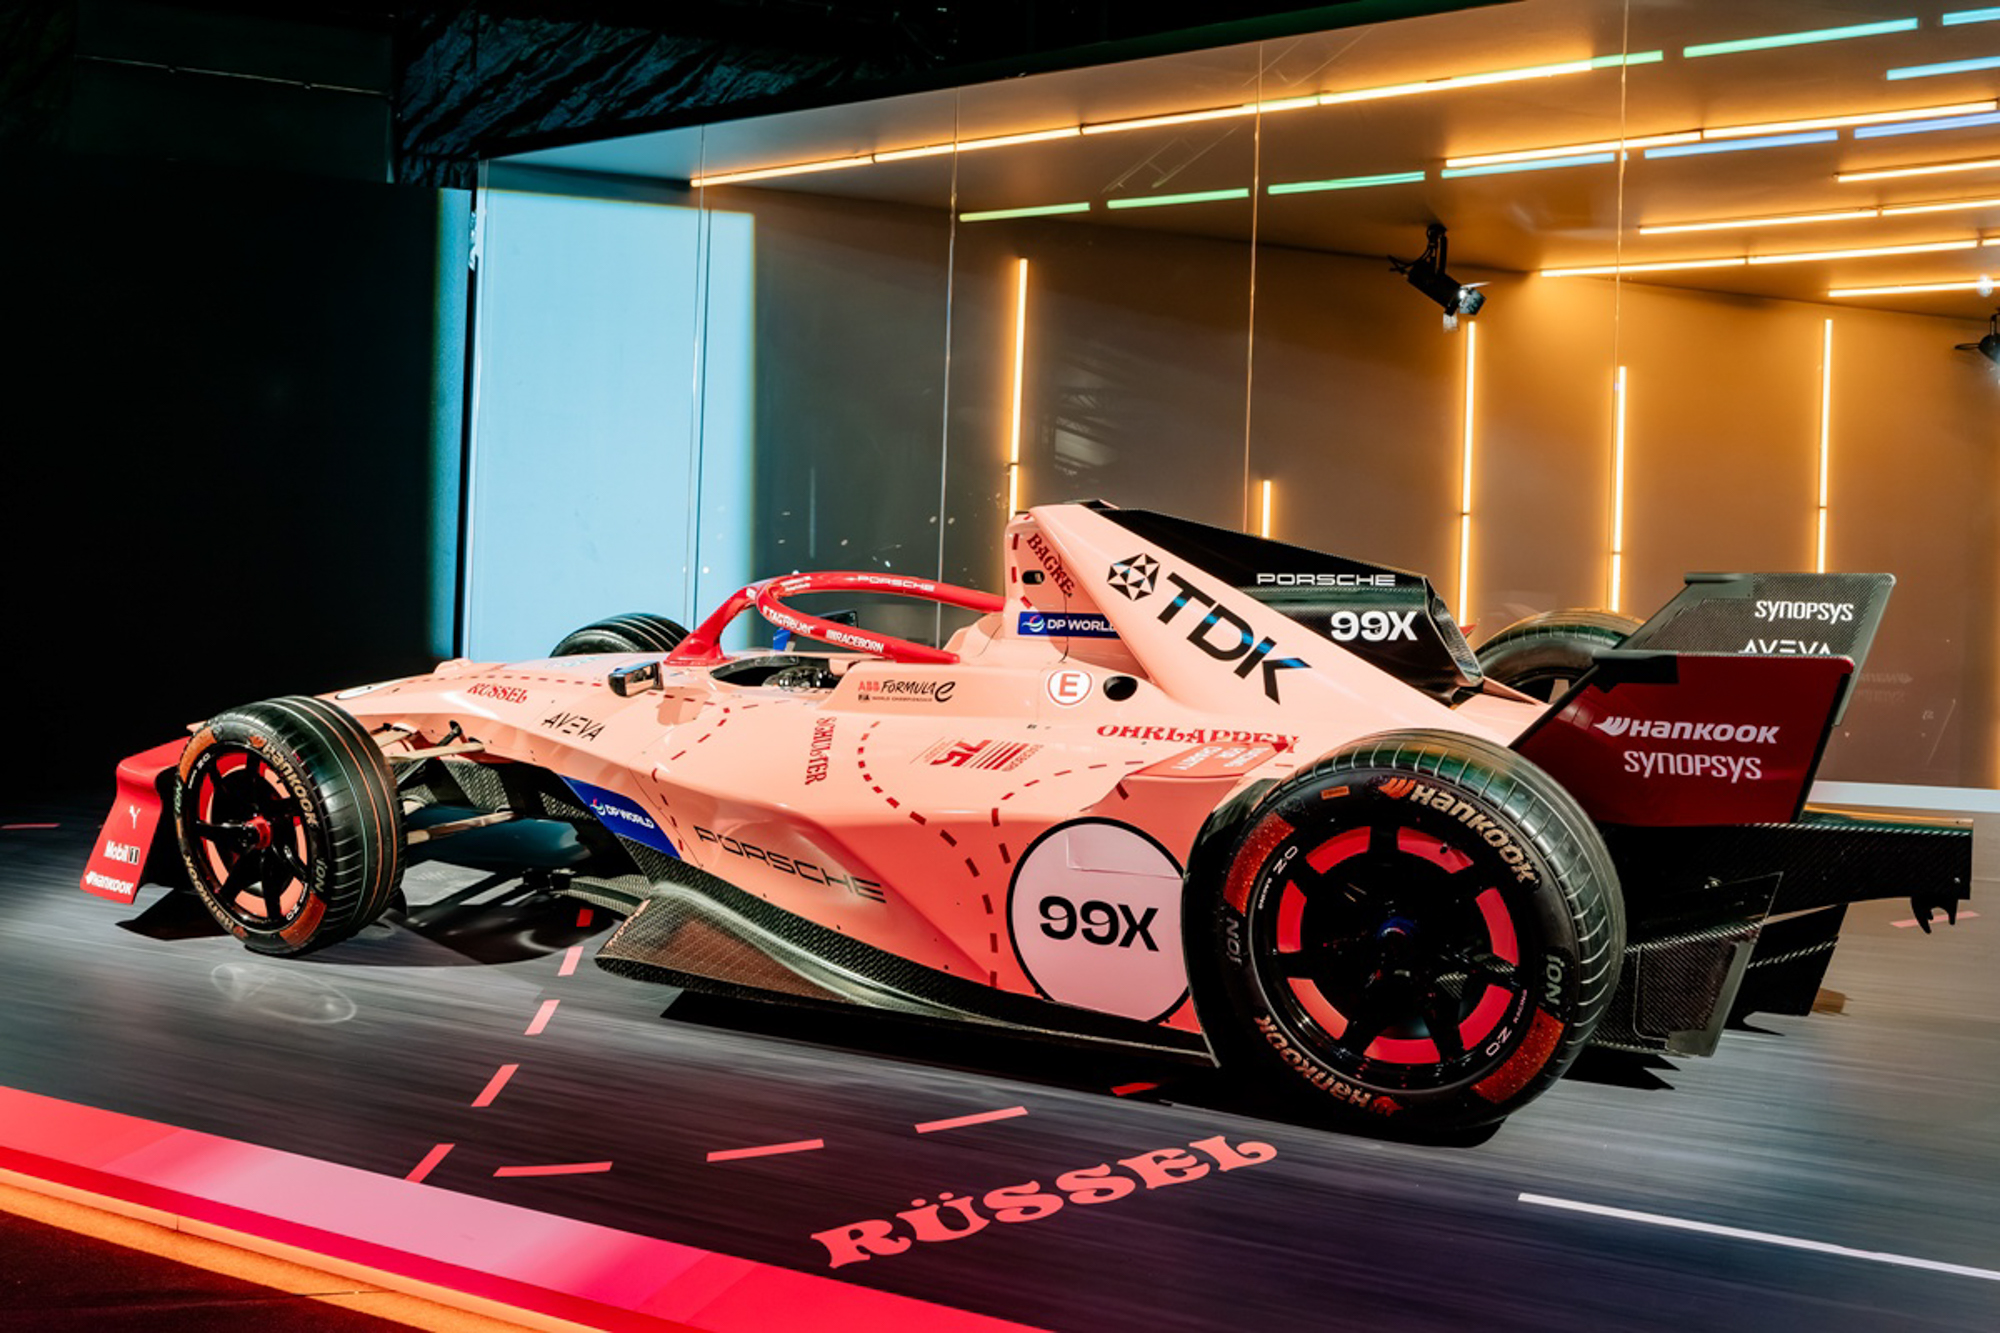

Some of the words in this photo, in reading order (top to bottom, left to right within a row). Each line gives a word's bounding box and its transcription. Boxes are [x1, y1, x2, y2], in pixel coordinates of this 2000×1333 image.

[857, 575, 935, 592] PORSCHE
[1256, 573, 1396, 587] PORSCHE
[1047, 619, 1067, 630] DP
[1754, 600, 1854, 625] SYNOPSYS
[1157, 572, 1312, 705] TDK
[1331, 610, 1418, 642] 99X
[836, 632, 884, 653] RACEBORN
[1738, 639, 1831, 655] AVEVA
[858, 681, 880, 691] ABB
[881, 680, 937, 695] FORMULA
[1059, 673, 1080, 697] E
[542, 712, 605, 741] AVEVA
[1623, 750, 1763, 784] SYNOPSYS
[604, 804, 619, 817] DP
[617, 808, 655, 829] WORLD
[104, 840, 129, 862] Mobil
[693, 825, 887, 903] PORSCHE
[1039, 895, 1160, 952] 99X
[810, 1134, 1278, 1269] RÜSSEL
